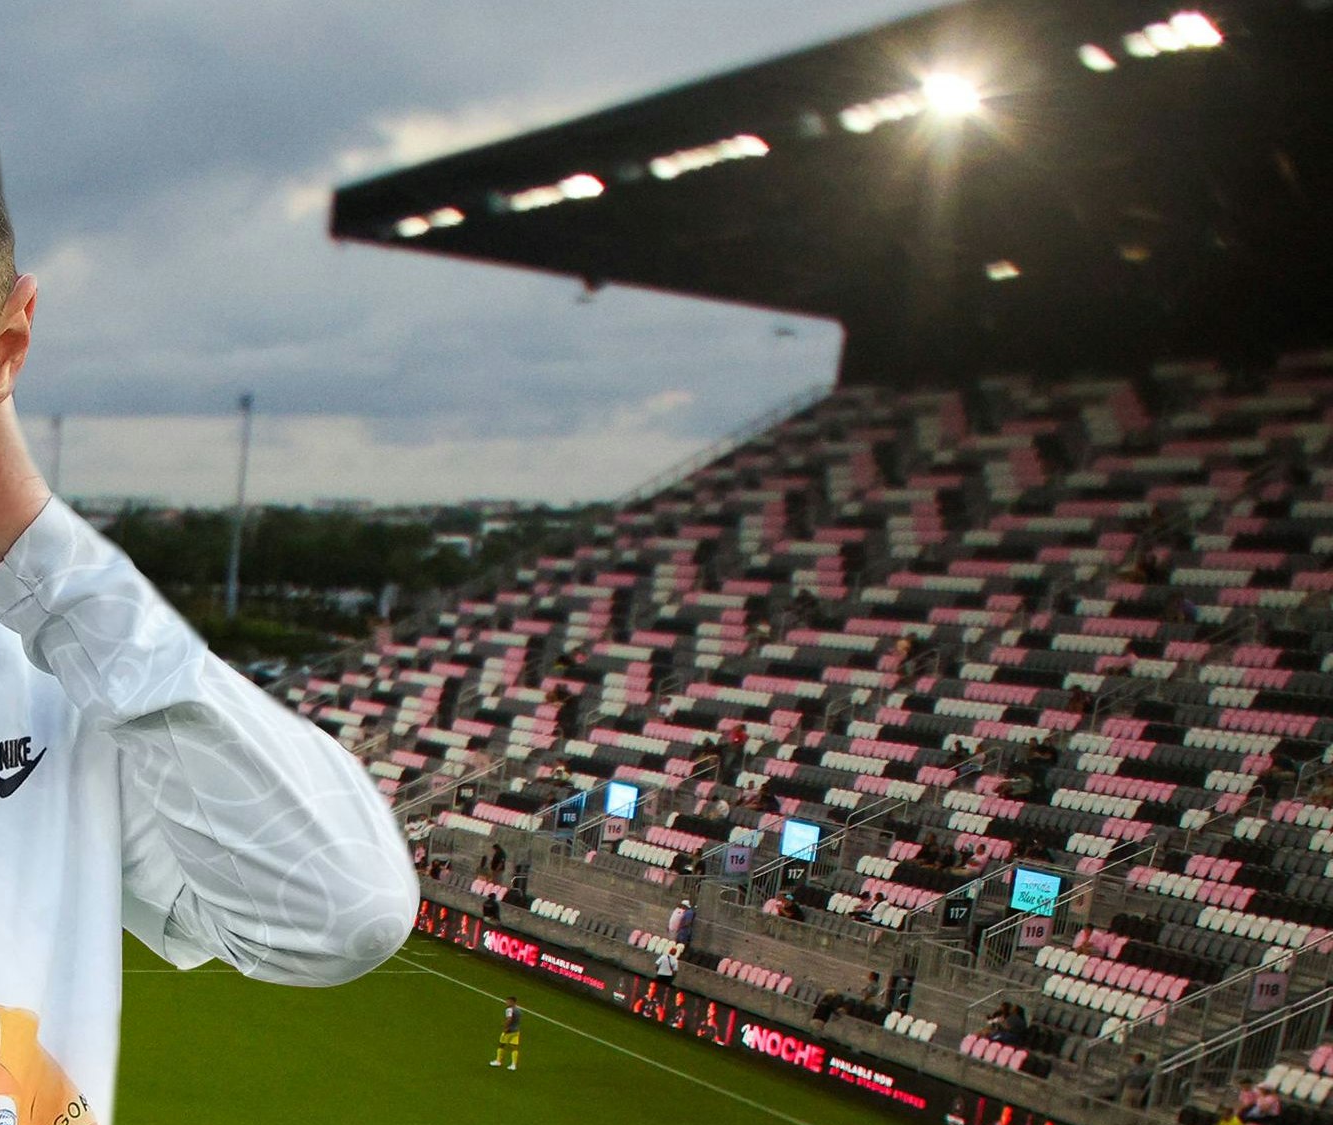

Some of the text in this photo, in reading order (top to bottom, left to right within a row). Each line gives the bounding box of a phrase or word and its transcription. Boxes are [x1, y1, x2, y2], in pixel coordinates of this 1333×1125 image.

[607, 824, 621, 834] 116
[730, 855, 745, 865] 116
[788, 868, 805, 879] 117
[950, 907, 968, 919] 117
[1025, 926, 1044, 938] 118
[489, 930, 540, 967] NOCHE
[749, 1025, 827, 1074] NOCHE
[829, 1057, 873, 1081] AVAILABLE
